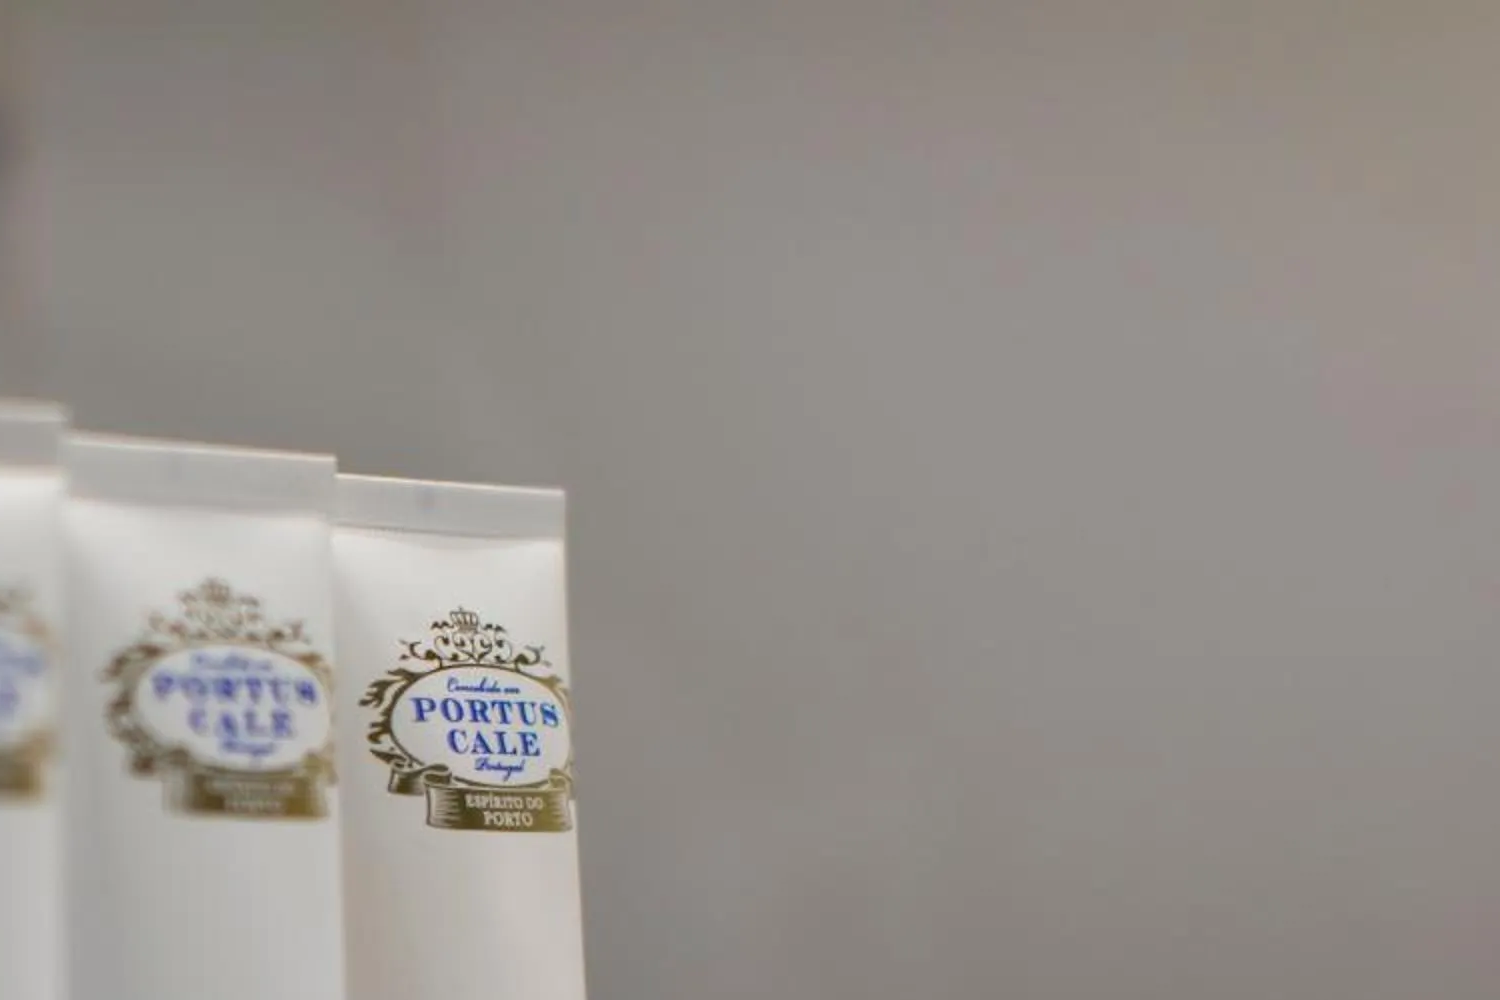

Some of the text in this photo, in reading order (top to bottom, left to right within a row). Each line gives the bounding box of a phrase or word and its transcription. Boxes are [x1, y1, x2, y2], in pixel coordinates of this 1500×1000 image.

[411, 697, 559, 727] PORTUS
[446, 728, 541, 757] CALE
[483, 811, 534, 827] PORTO
